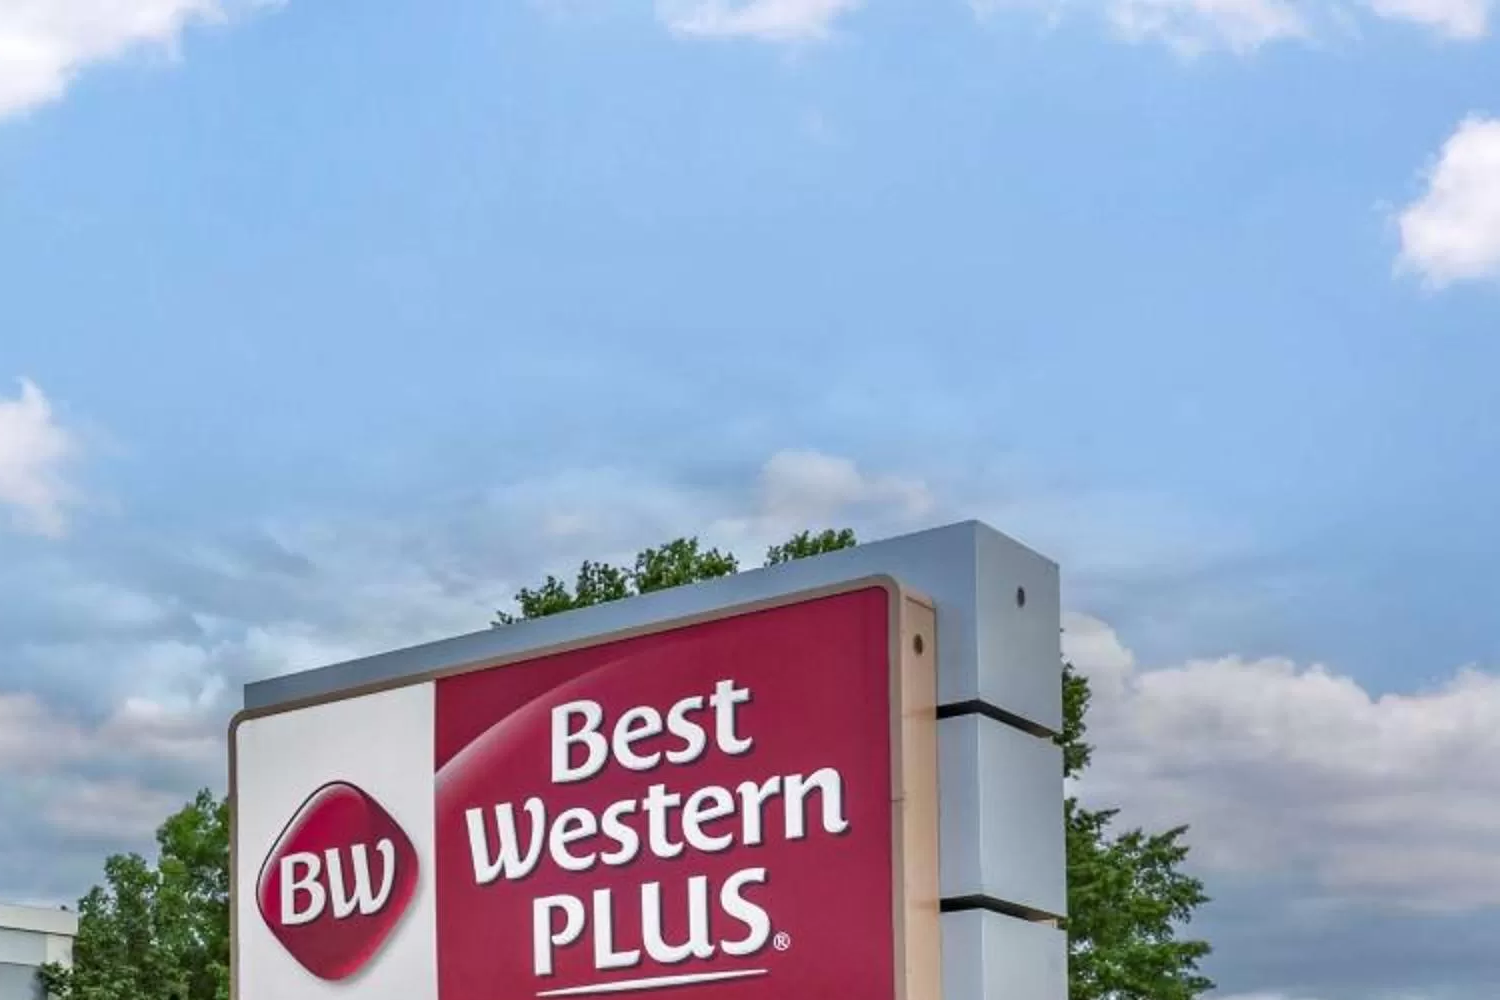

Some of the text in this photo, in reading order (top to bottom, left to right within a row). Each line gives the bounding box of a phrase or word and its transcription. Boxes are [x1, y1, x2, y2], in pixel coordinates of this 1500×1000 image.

[550, 679, 753, 784] Best
[465, 767, 850, 886] Western
[279, 839, 397, 926] BW
[531, 867, 772, 976] PLUS
